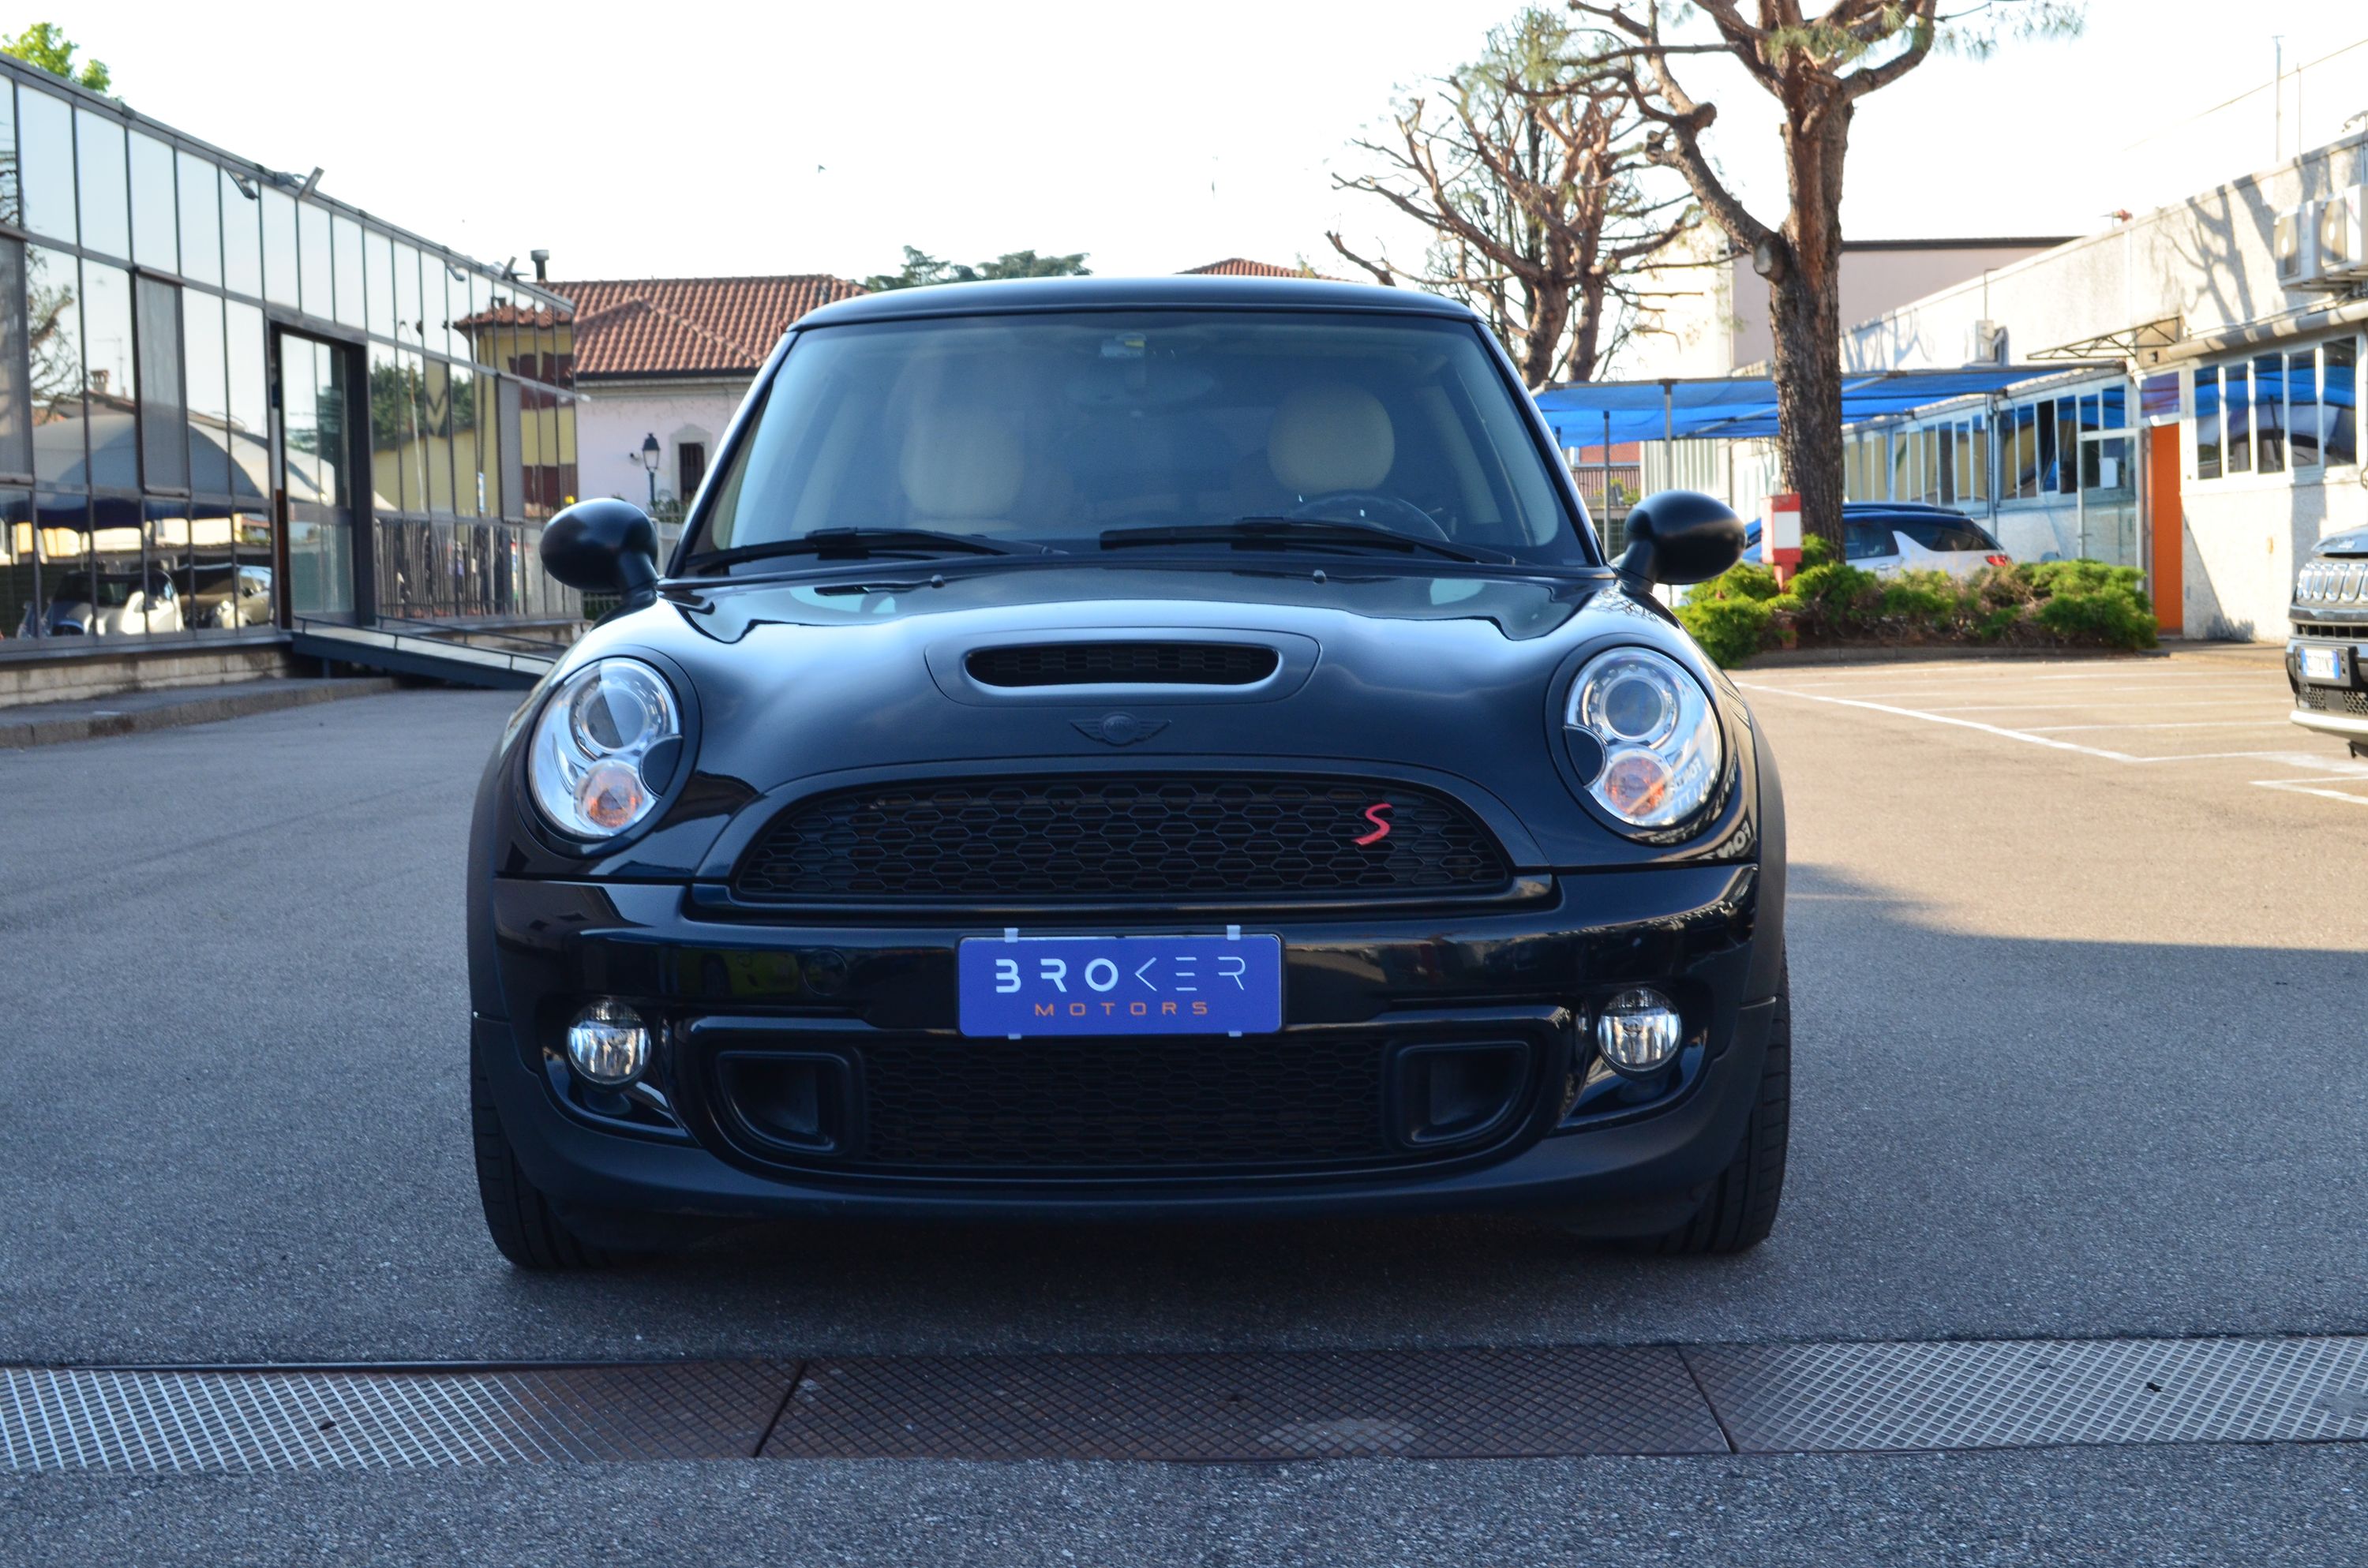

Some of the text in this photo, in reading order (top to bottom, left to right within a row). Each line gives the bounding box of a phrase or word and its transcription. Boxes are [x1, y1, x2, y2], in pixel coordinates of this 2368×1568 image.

[1352, 803, 1392, 845] S
[995, 956, 1246, 993] BROKER
[1034, 1001, 1208, 1016] MOTORS
